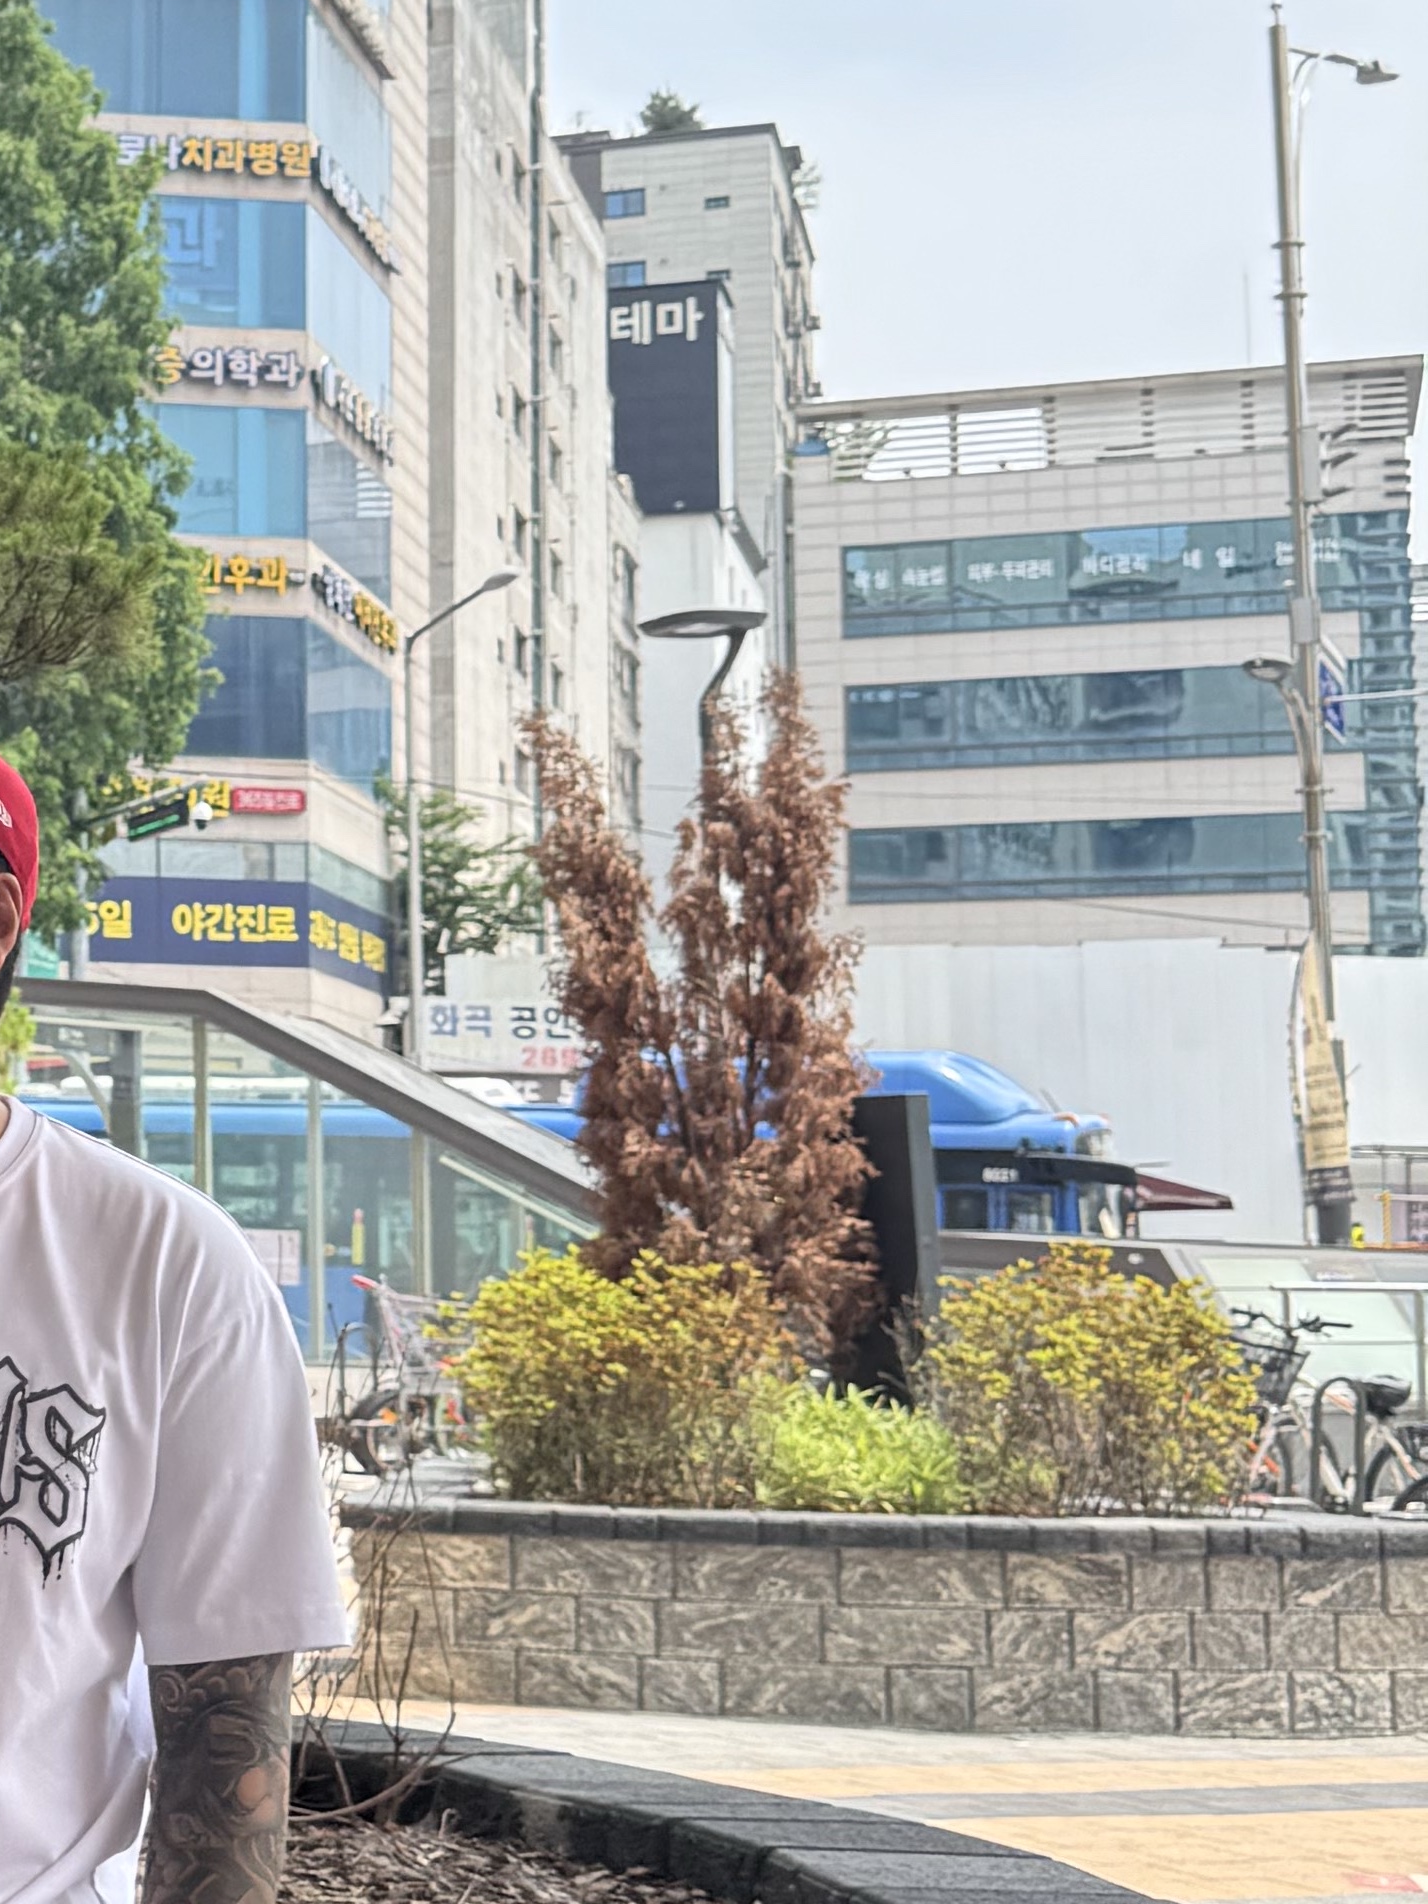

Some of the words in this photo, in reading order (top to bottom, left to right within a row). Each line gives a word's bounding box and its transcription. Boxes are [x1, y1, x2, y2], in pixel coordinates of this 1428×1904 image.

[609, 296, 705, 346] 테마
[154, 346, 302, 389] 증의학과
[171, 901, 300, 943] 야간진료
[429, 1004, 492, 1038] 화곡
